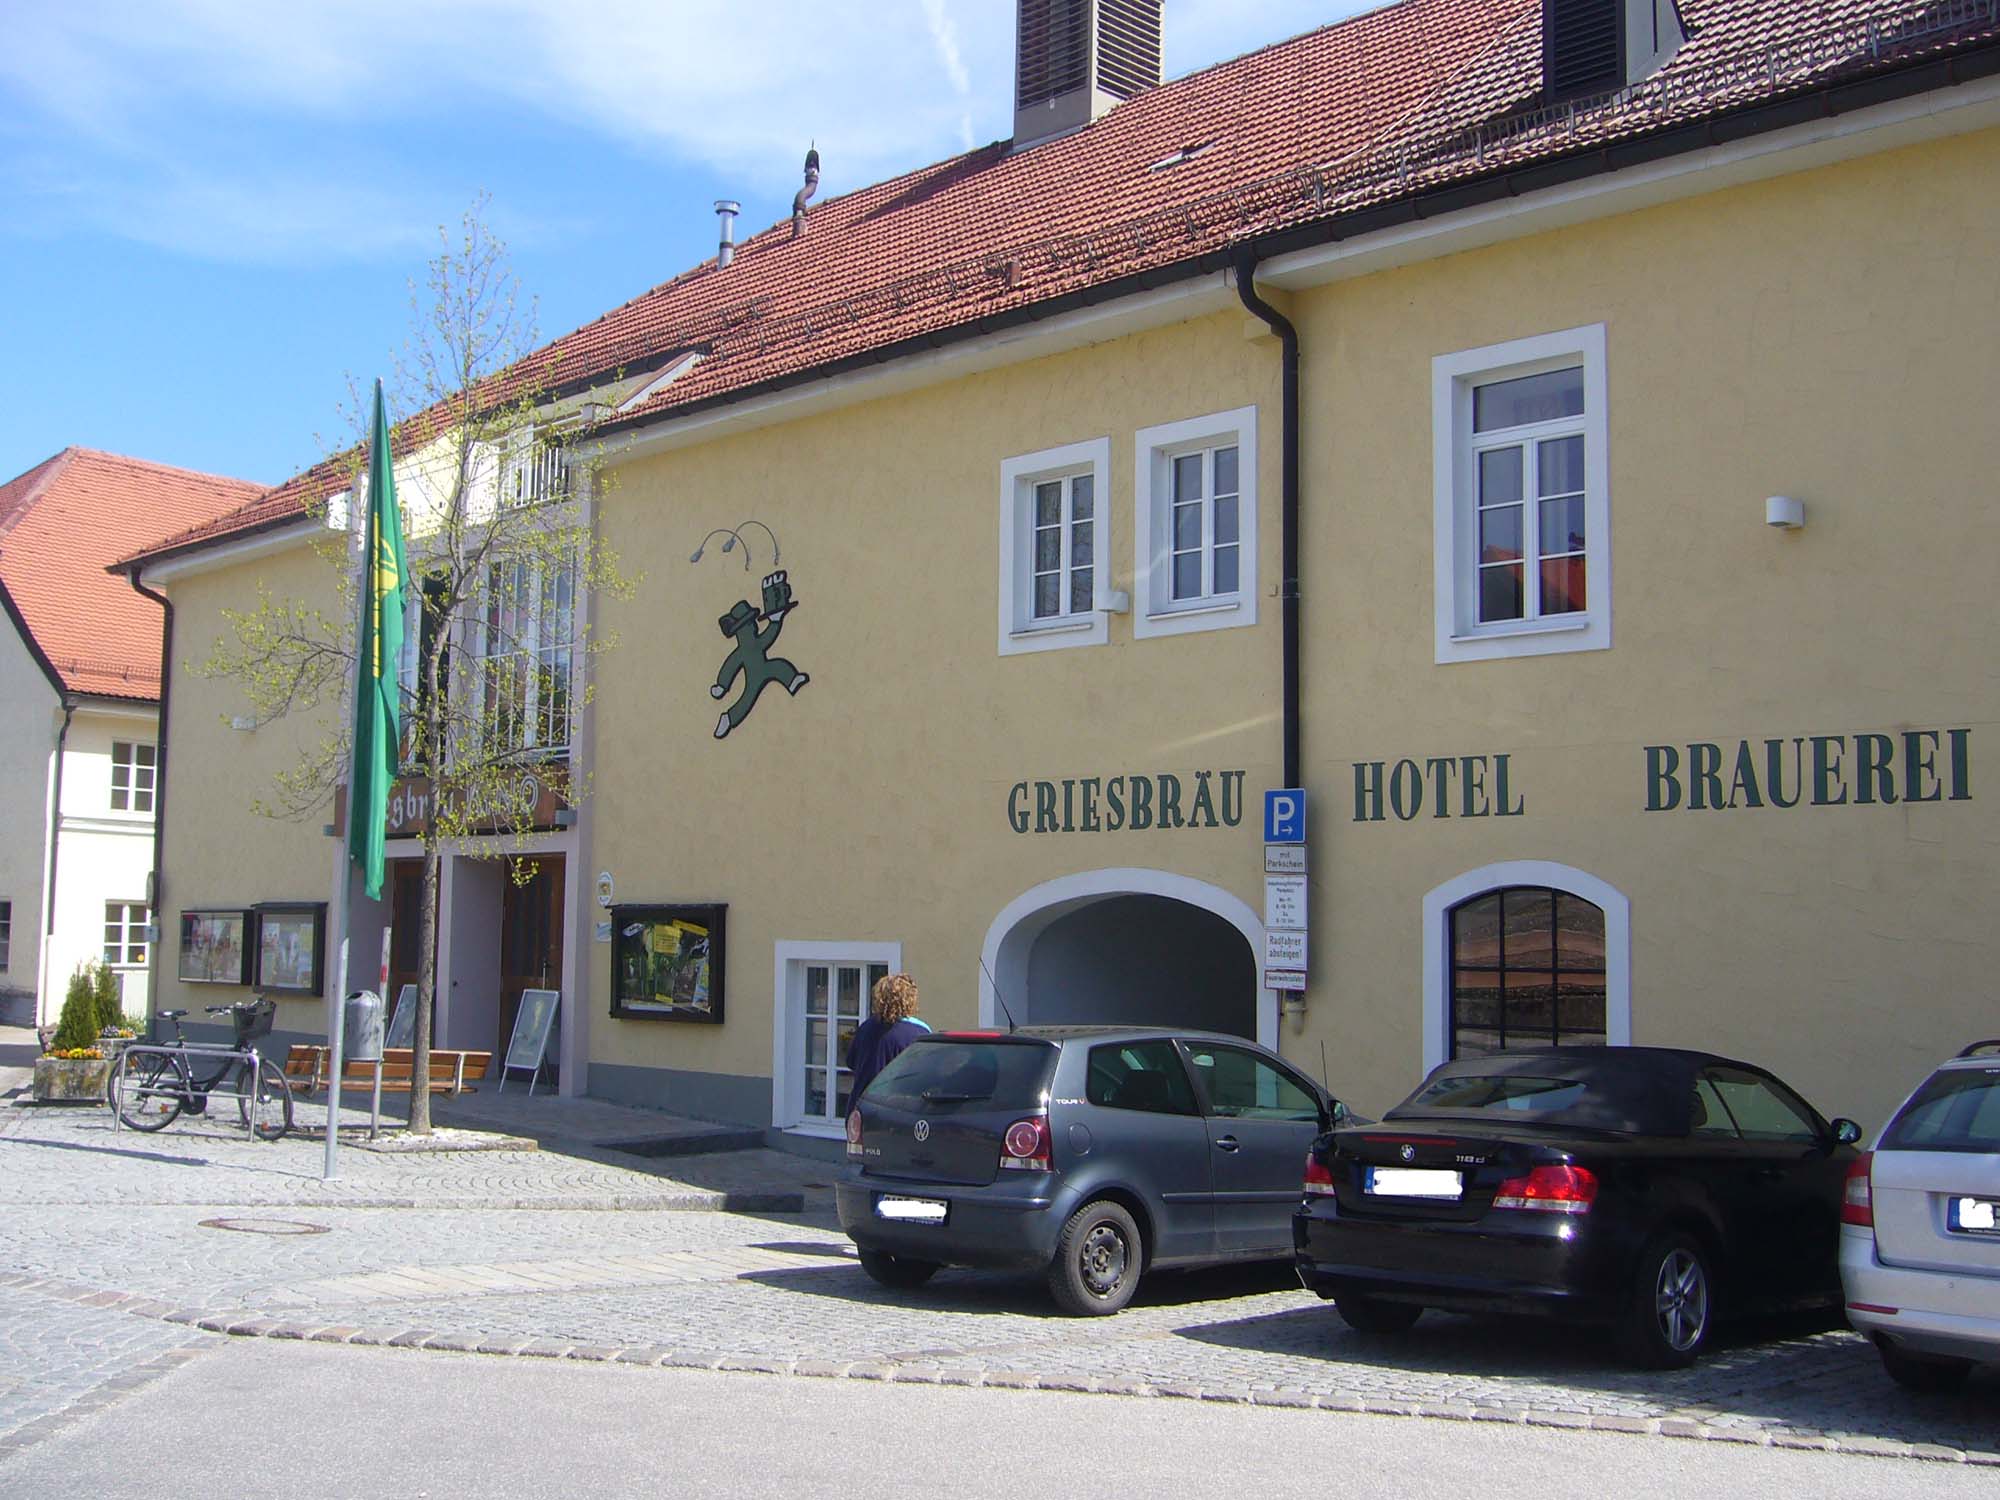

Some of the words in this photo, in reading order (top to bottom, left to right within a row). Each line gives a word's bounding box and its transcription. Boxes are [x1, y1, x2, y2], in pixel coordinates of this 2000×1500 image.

[1007, 770, 1246, 833] GRIESBRÄU
[1352, 754, 1525, 822] HOTEL
[1643, 728, 1973, 812] BRAUEREI
[1273, 796, 1296, 836] P
